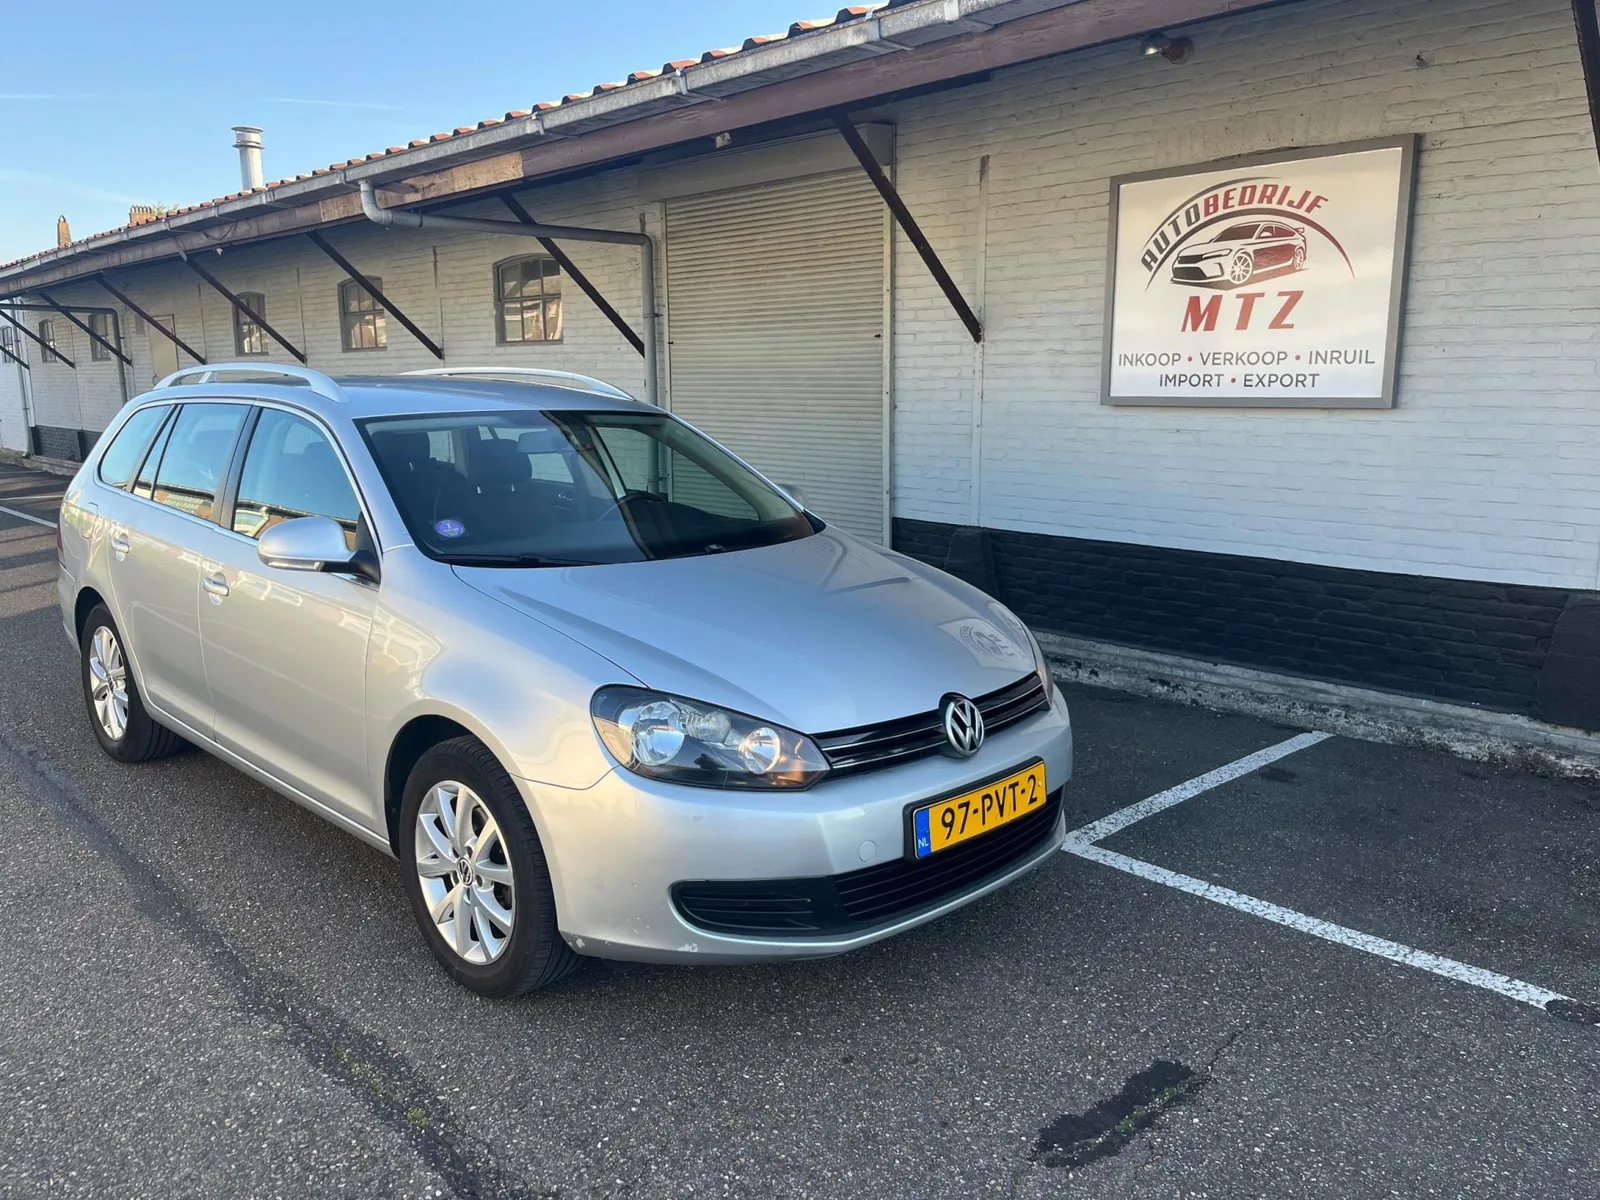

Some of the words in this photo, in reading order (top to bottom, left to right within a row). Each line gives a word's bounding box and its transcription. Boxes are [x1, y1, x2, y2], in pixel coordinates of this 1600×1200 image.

[1141, 184, 1328, 272] AUTOBEDRIJF
[1181, 290, 1304, 332] MTZ
[1118, 352, 1181, 366] INKOOP
[1200, 351, 1288, 366] VERKOOP
[1308, 350, 1375, 365] INRUIL
[1159, 373, 1224, 387] IMPORT
[1243, 373, 1319, 388] EXPORT
[941, 774, 1037, 841] 97-PVT-2
[918, 838, 929, 849] NL
